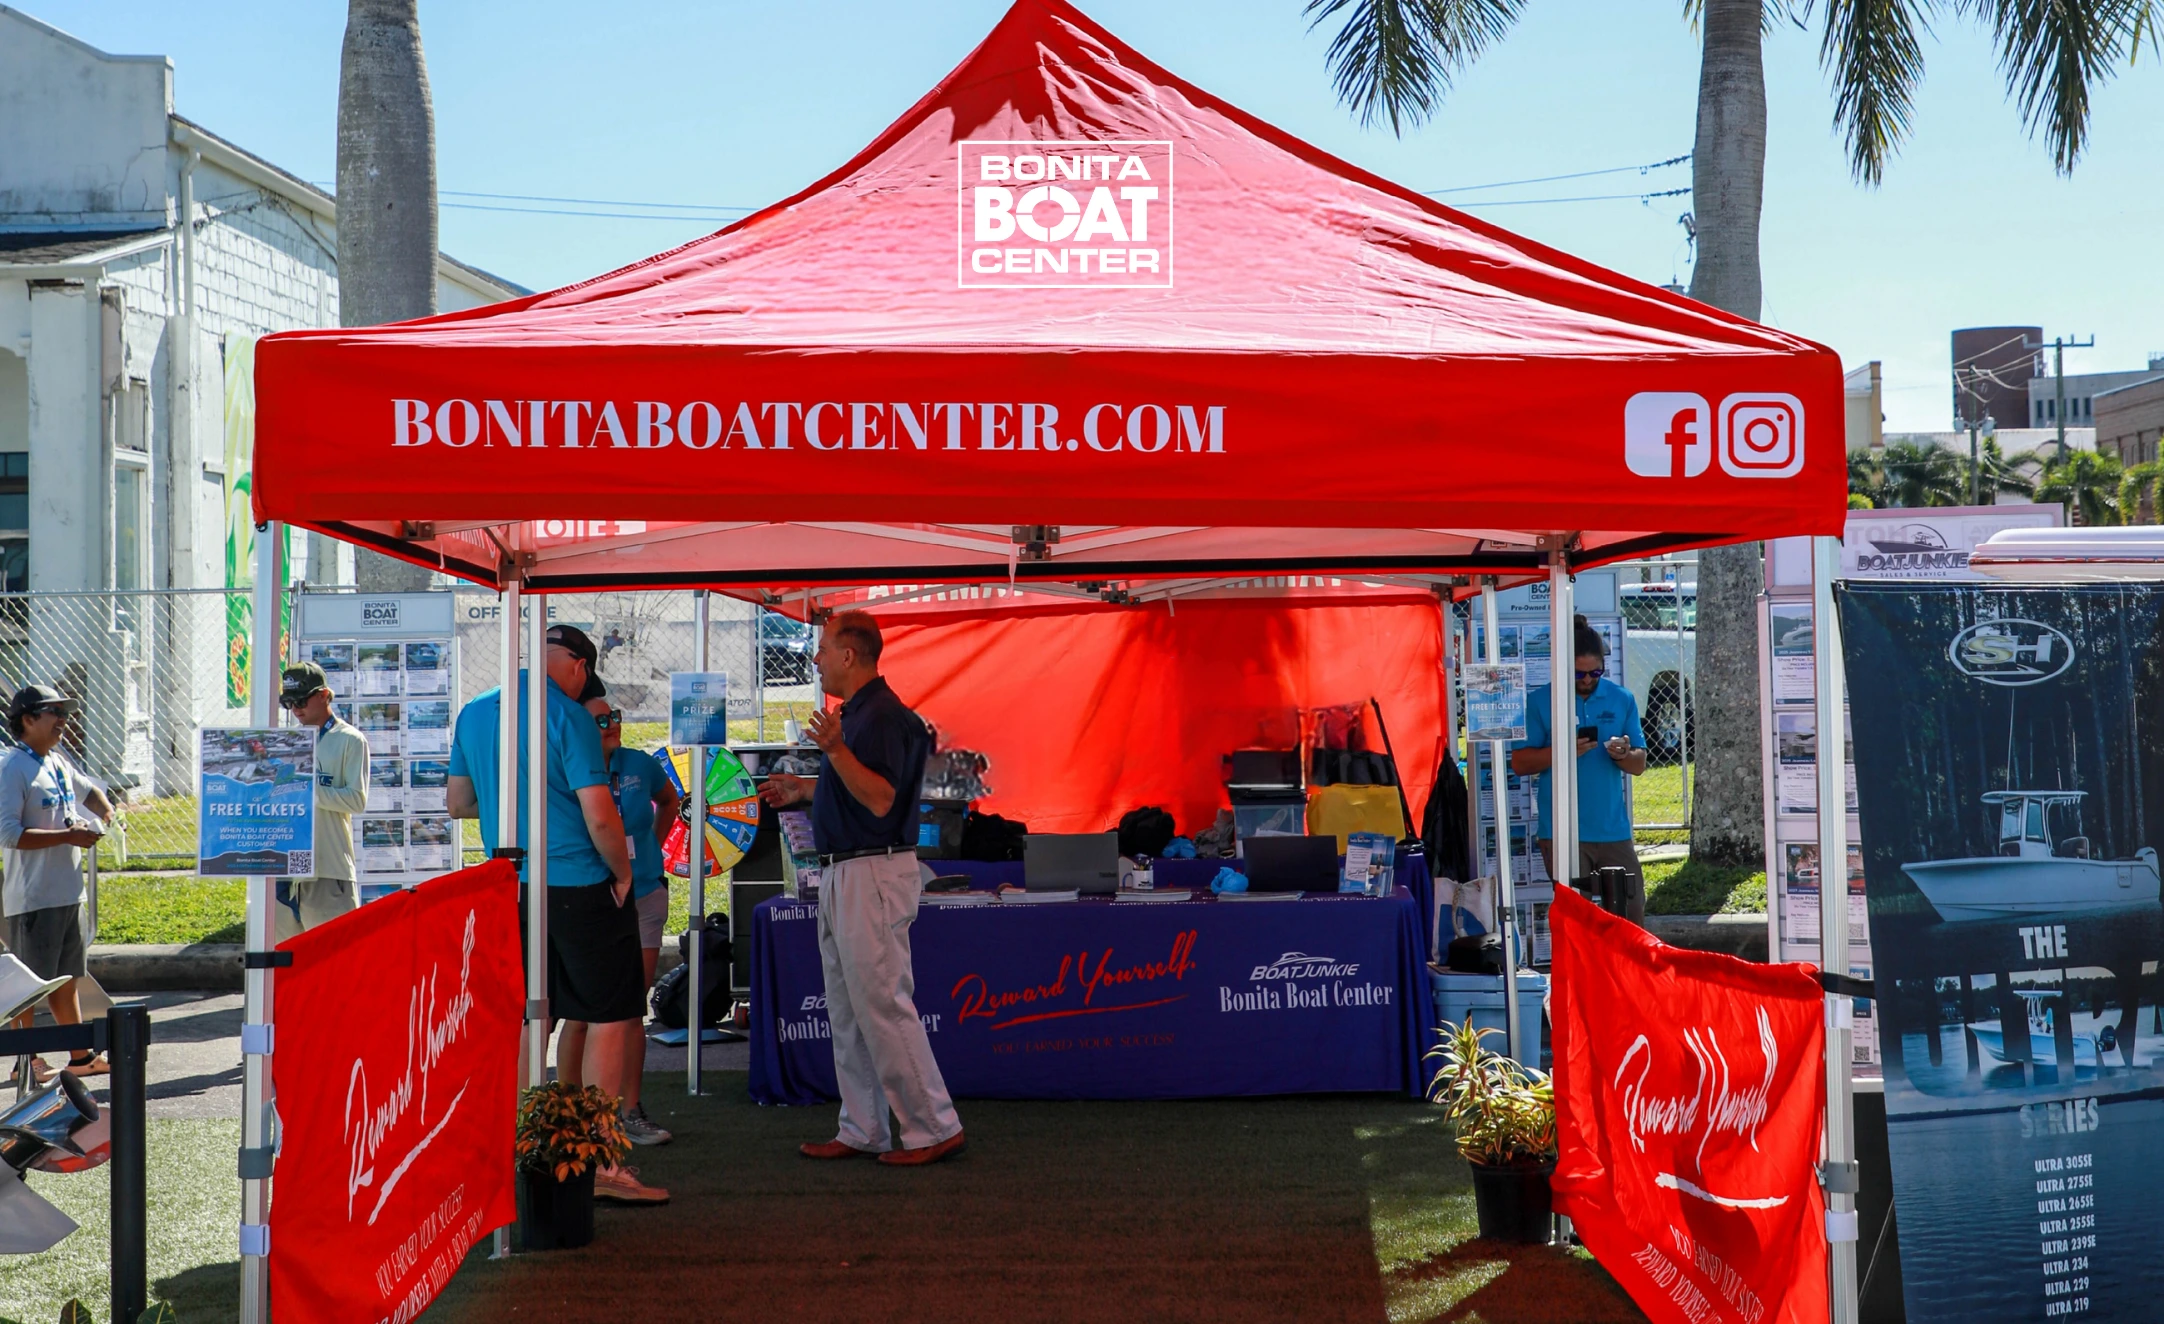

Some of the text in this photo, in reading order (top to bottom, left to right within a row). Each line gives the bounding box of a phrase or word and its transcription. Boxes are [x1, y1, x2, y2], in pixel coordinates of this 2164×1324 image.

[981, 155, 1151, 181] BONITA
[974, 185, 1159, 242] BOAT
[971, 248, 1160, 274] CENTER
[391, 398, 1227, 453] BONITABOATCENTER.COM
[1857, 552, 1969, 571] BOATJUNKIE
[1531, 584, 1551, 594] BO
[363, 608, 398, 619] BOAT
[683, 706, 716, 715] PRIZE
[1471, 703, 1489, 711] FREE
[209, 803, 306, 817] FREE TICKETS
[738, 804, 746, 815] 20
[669, 826, 682, 842] TIX
[712, 818, 729, 829] TIX
[770, 904, 805, 922] Bonita
[2018, 925, 2069, 960] THE
[952, 929, 1198, 1025] Reward Yourself.
[1249, 963, 1360, 981] BOATJUNKIE
[1219, 979, 1393, 1013] Bonita Boat Center
[777, 1014, 832, 1043] Bonita
[992, 1041, 1019, 1054] YOU
[1026, 1038, 1072, 1052] EARNED
[1079, 1036, 1114, 1049] YOUR
[1614, 1027, 1707, 1154] Reward
[344, 985, 416, 1222] Reward
[2019, 1097, 2100, 1139] SERIES
[2034, 1153, 2093, 1173] ULTRA 305SE
[2036, 1174, 2093, 1194] ULTRA 275SE
[2038, 1194, 2095, 1214] ULTRA 265SE
[2039, 1214, 2095, 1235] ULTRA 255SE
[375, 1258, 394, 1299] YOU
[391, 1232, 418, 1283] EARNED
[419, 1211, 437, 1253] YOUR
[2041, 1234, 2096, 1255] ULTRA 239SE
[428, 1252, 449, 1295] WITH
[447, 1246, 456, 1274] A
[1630, 1242, 1678, 1288] REWARD
[1669, 1224, 1692, 1260] YOU
[1693, 1239, 1723, 1285] EARNED
[1720, 1263, 1742, 1305] YOUR
[2043, 1256, 2089, 1276] ULTRA 234
[2045, 1276, 2090, 1297] ULTRA 229
[2046, 1297, 2090, 1317] ULTRA 219
